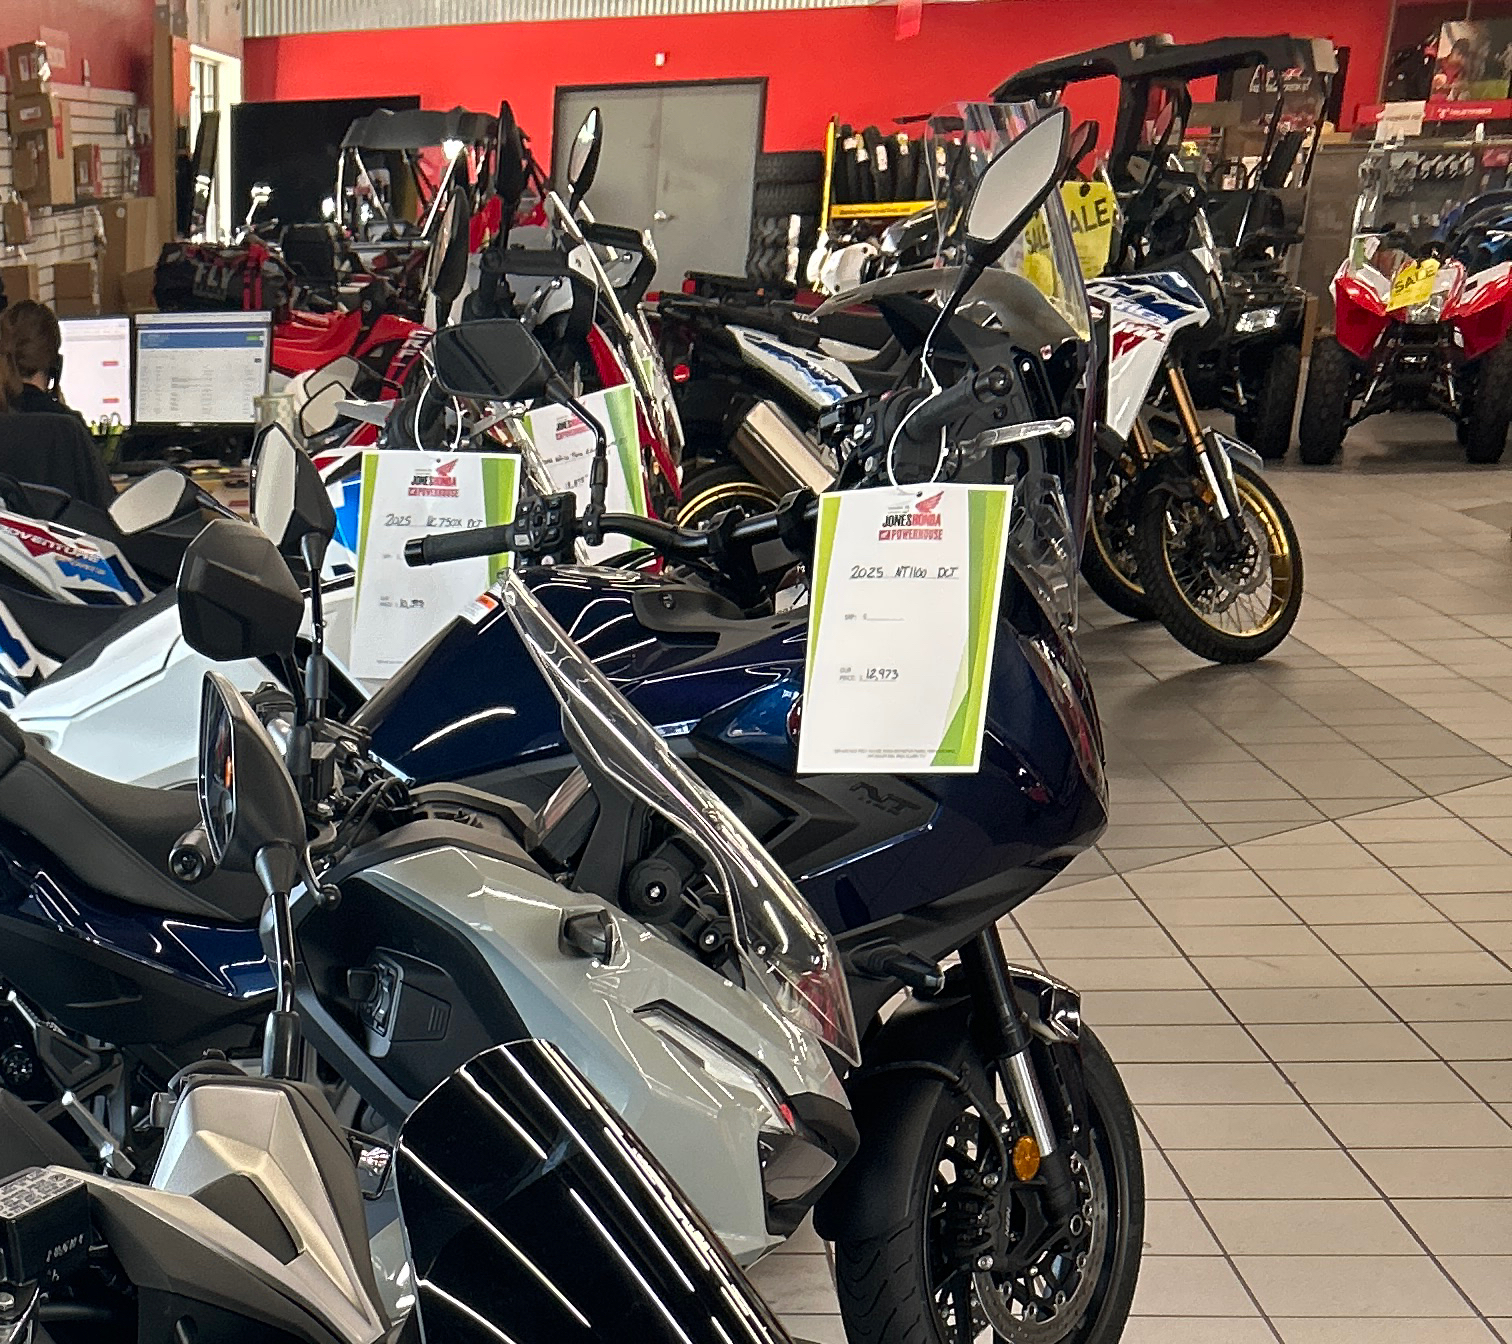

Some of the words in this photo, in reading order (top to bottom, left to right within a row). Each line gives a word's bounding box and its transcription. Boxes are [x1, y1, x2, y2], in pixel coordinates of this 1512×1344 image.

[1068, 197, 1111, 235] ALE
[1394, 265, 1436, 293] SALE
[891, 529, 943, 540] POWERHOUSE
[850, 565, 884, 579] 2025
[937, 567, 959, 578] DCT
